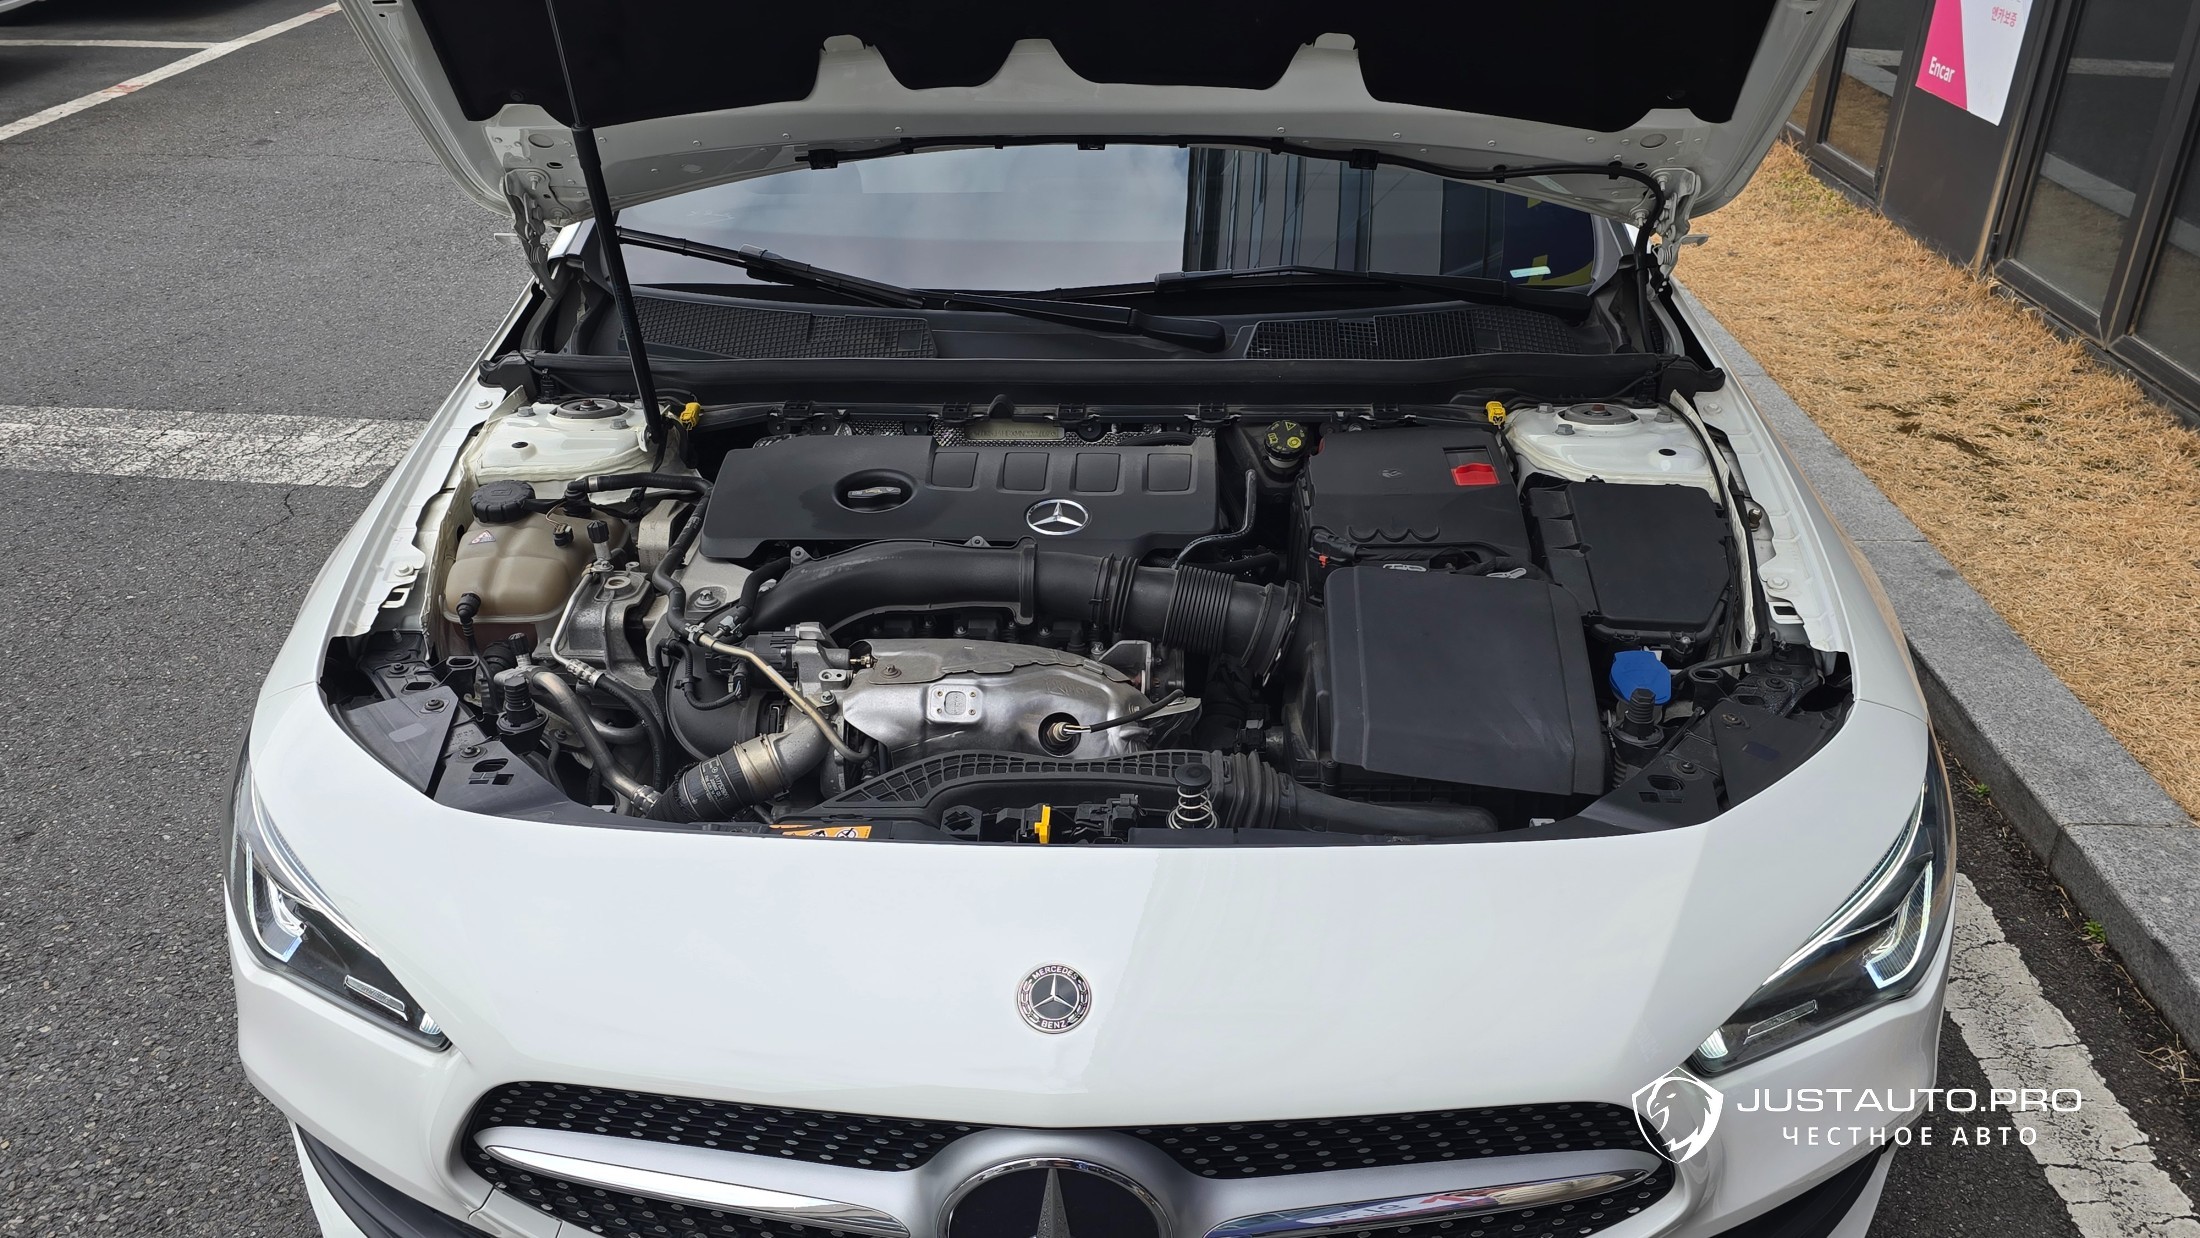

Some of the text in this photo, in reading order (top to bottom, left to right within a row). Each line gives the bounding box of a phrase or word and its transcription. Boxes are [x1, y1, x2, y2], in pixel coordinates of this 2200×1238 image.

[1991, 6, 2018, 28] 엔카보증
[1928, 56, 1955, 83] Encar
[1032, 966, 1079, 980] MERCEDES
[1041, 1020, 1067, 1029] BENZ
